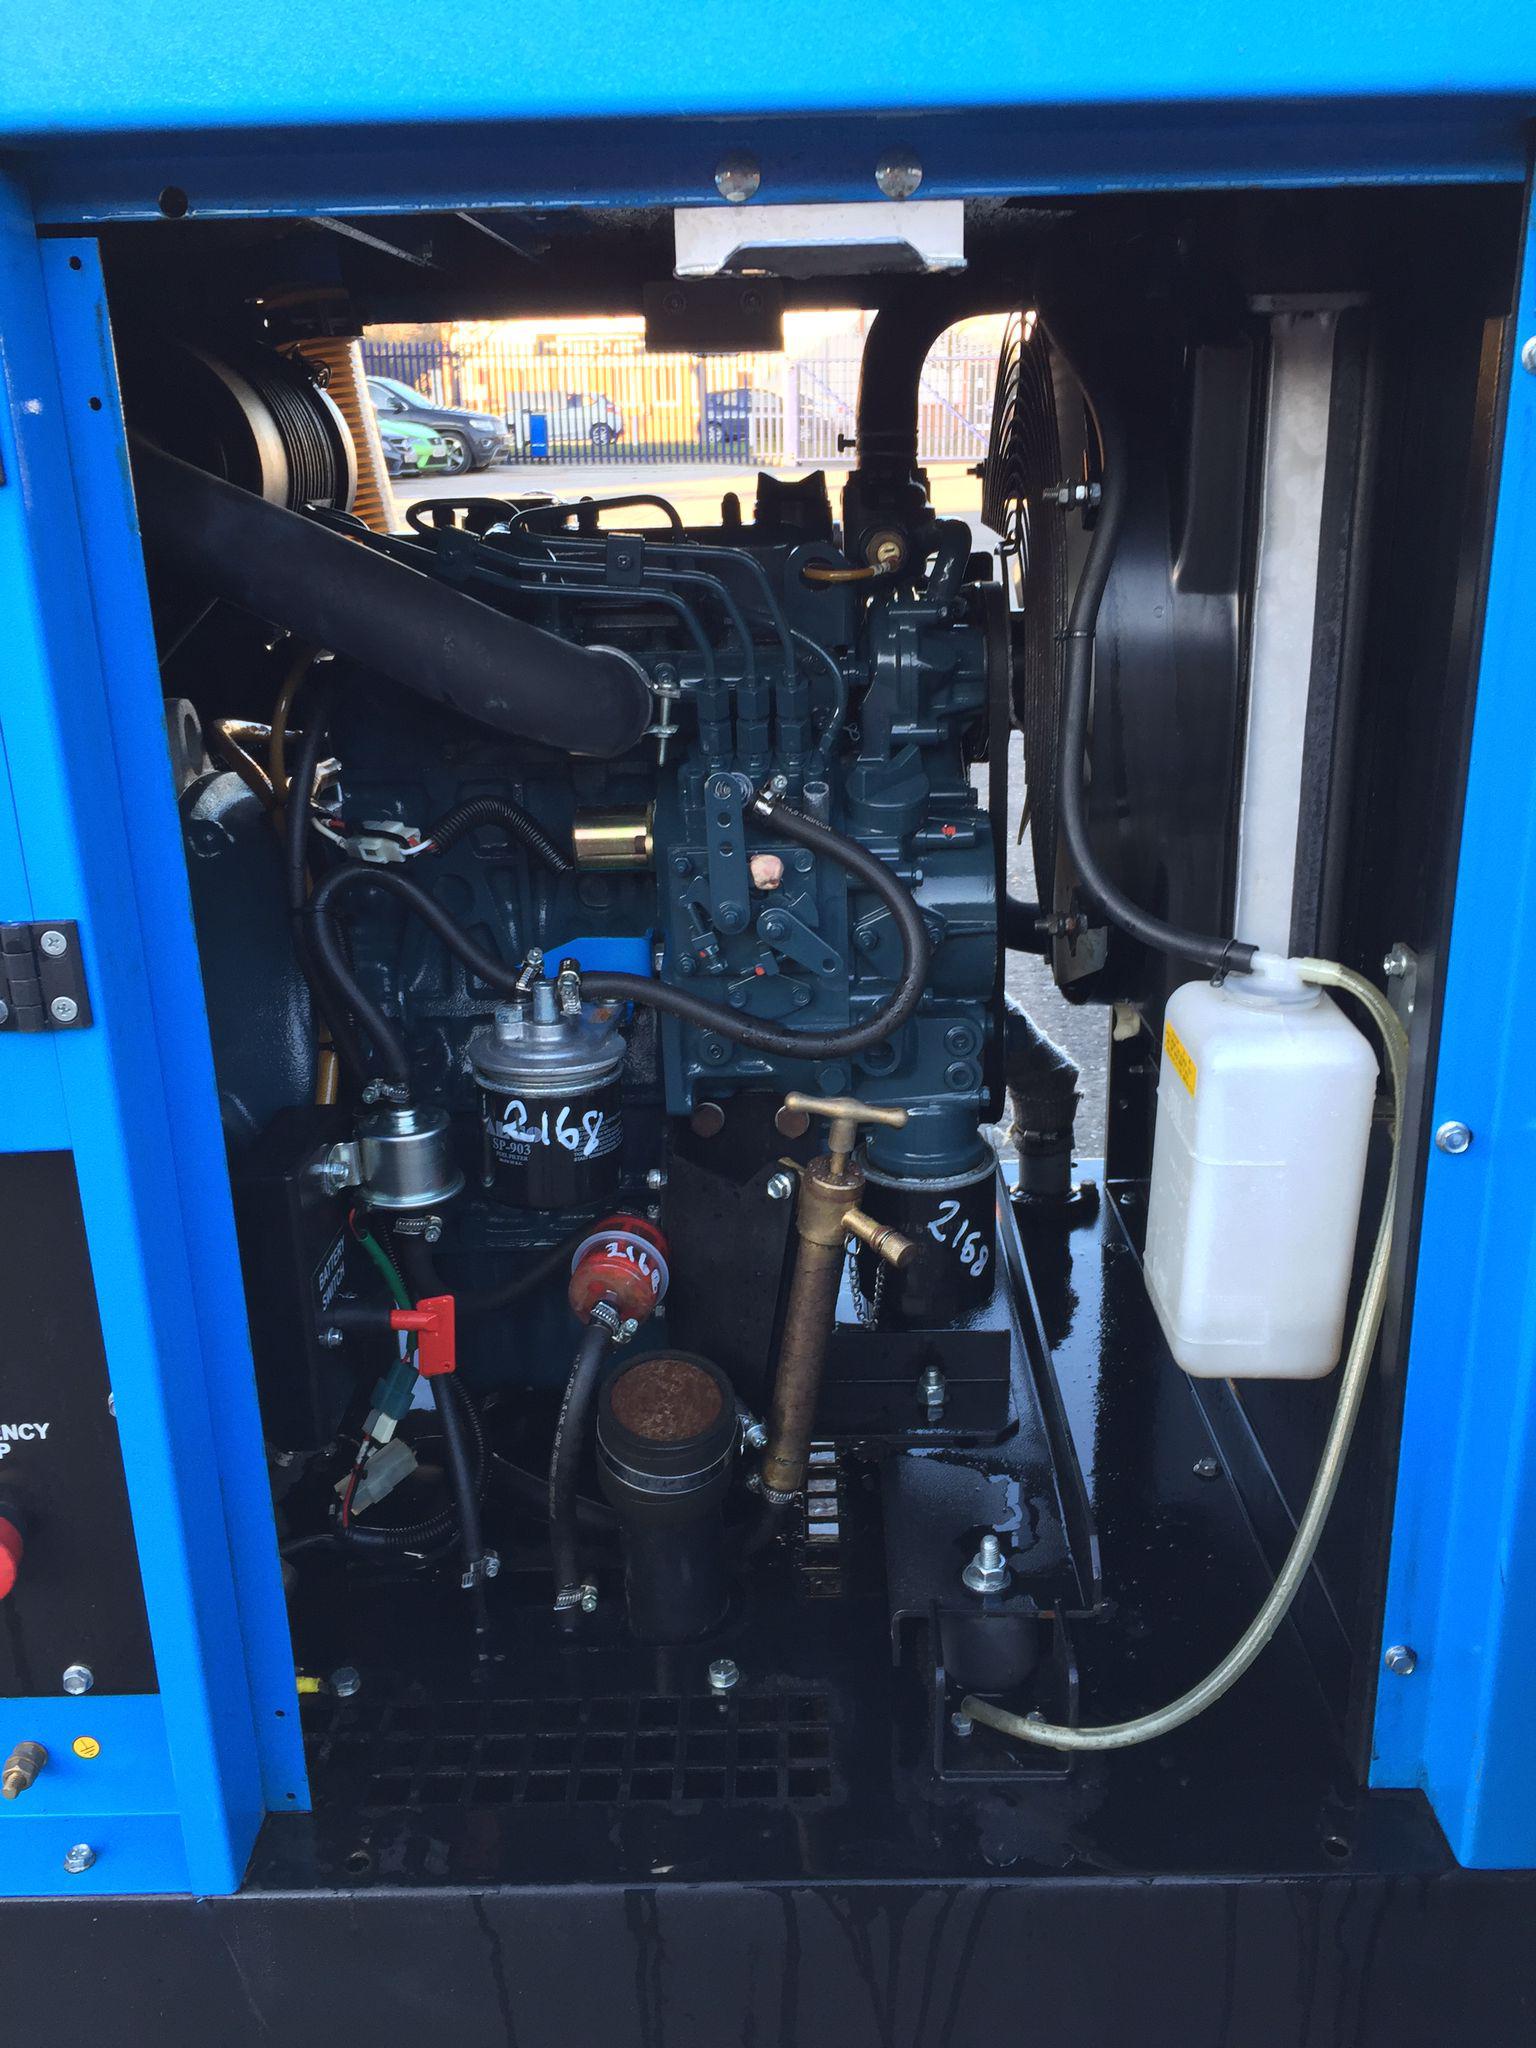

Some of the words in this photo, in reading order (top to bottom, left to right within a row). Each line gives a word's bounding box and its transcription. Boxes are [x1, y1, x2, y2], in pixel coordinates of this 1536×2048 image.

[492, 1137, 532, 1156] SP-903
[502, 1099, 604, 1156] 2168
[319, 1234, 345, 1292] BATTERY
[927, 1199, 990, 1278] 2168
[322, 1261, 345, 1311] SWITCH
[605, 1241, 661, 1294] 2168
[0, 1422, 50, 1440] NCY
